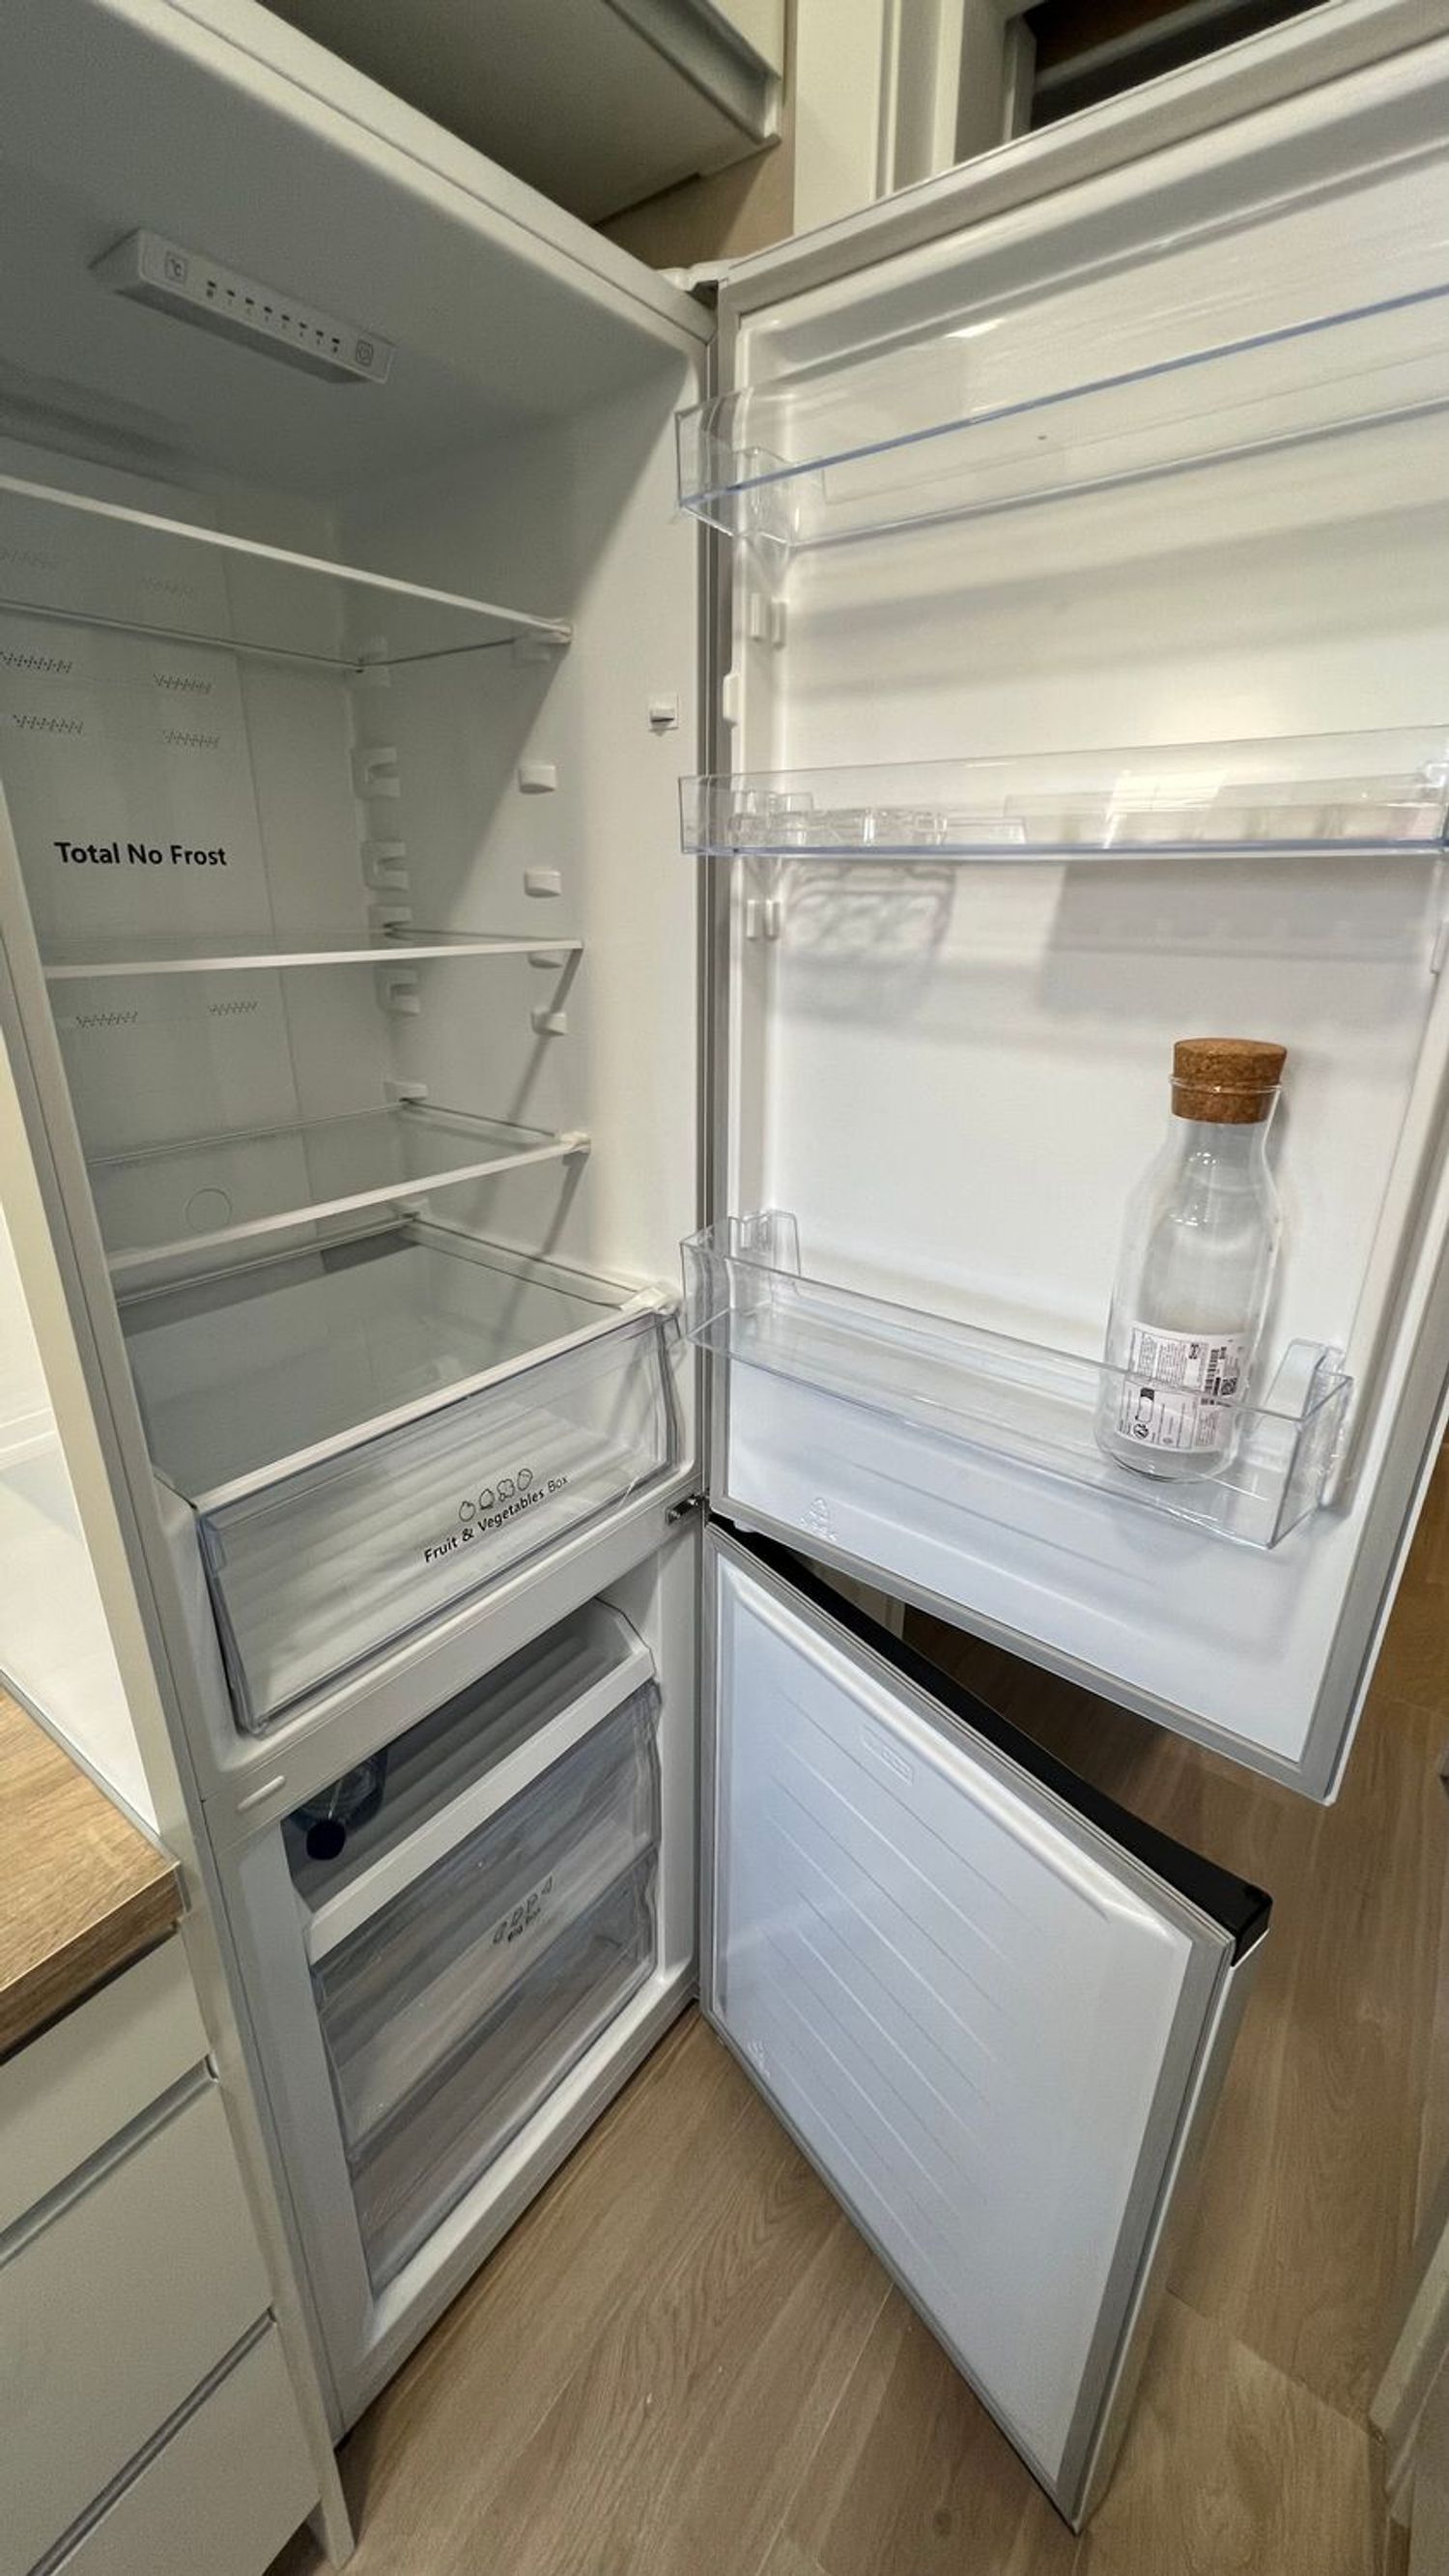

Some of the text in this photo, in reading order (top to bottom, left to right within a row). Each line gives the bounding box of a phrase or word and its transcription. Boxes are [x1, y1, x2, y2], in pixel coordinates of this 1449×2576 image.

[54, 842, 227, 866] Total No Frost
[424, 1476, 568, 1562] Fruit & Vegetables Box
